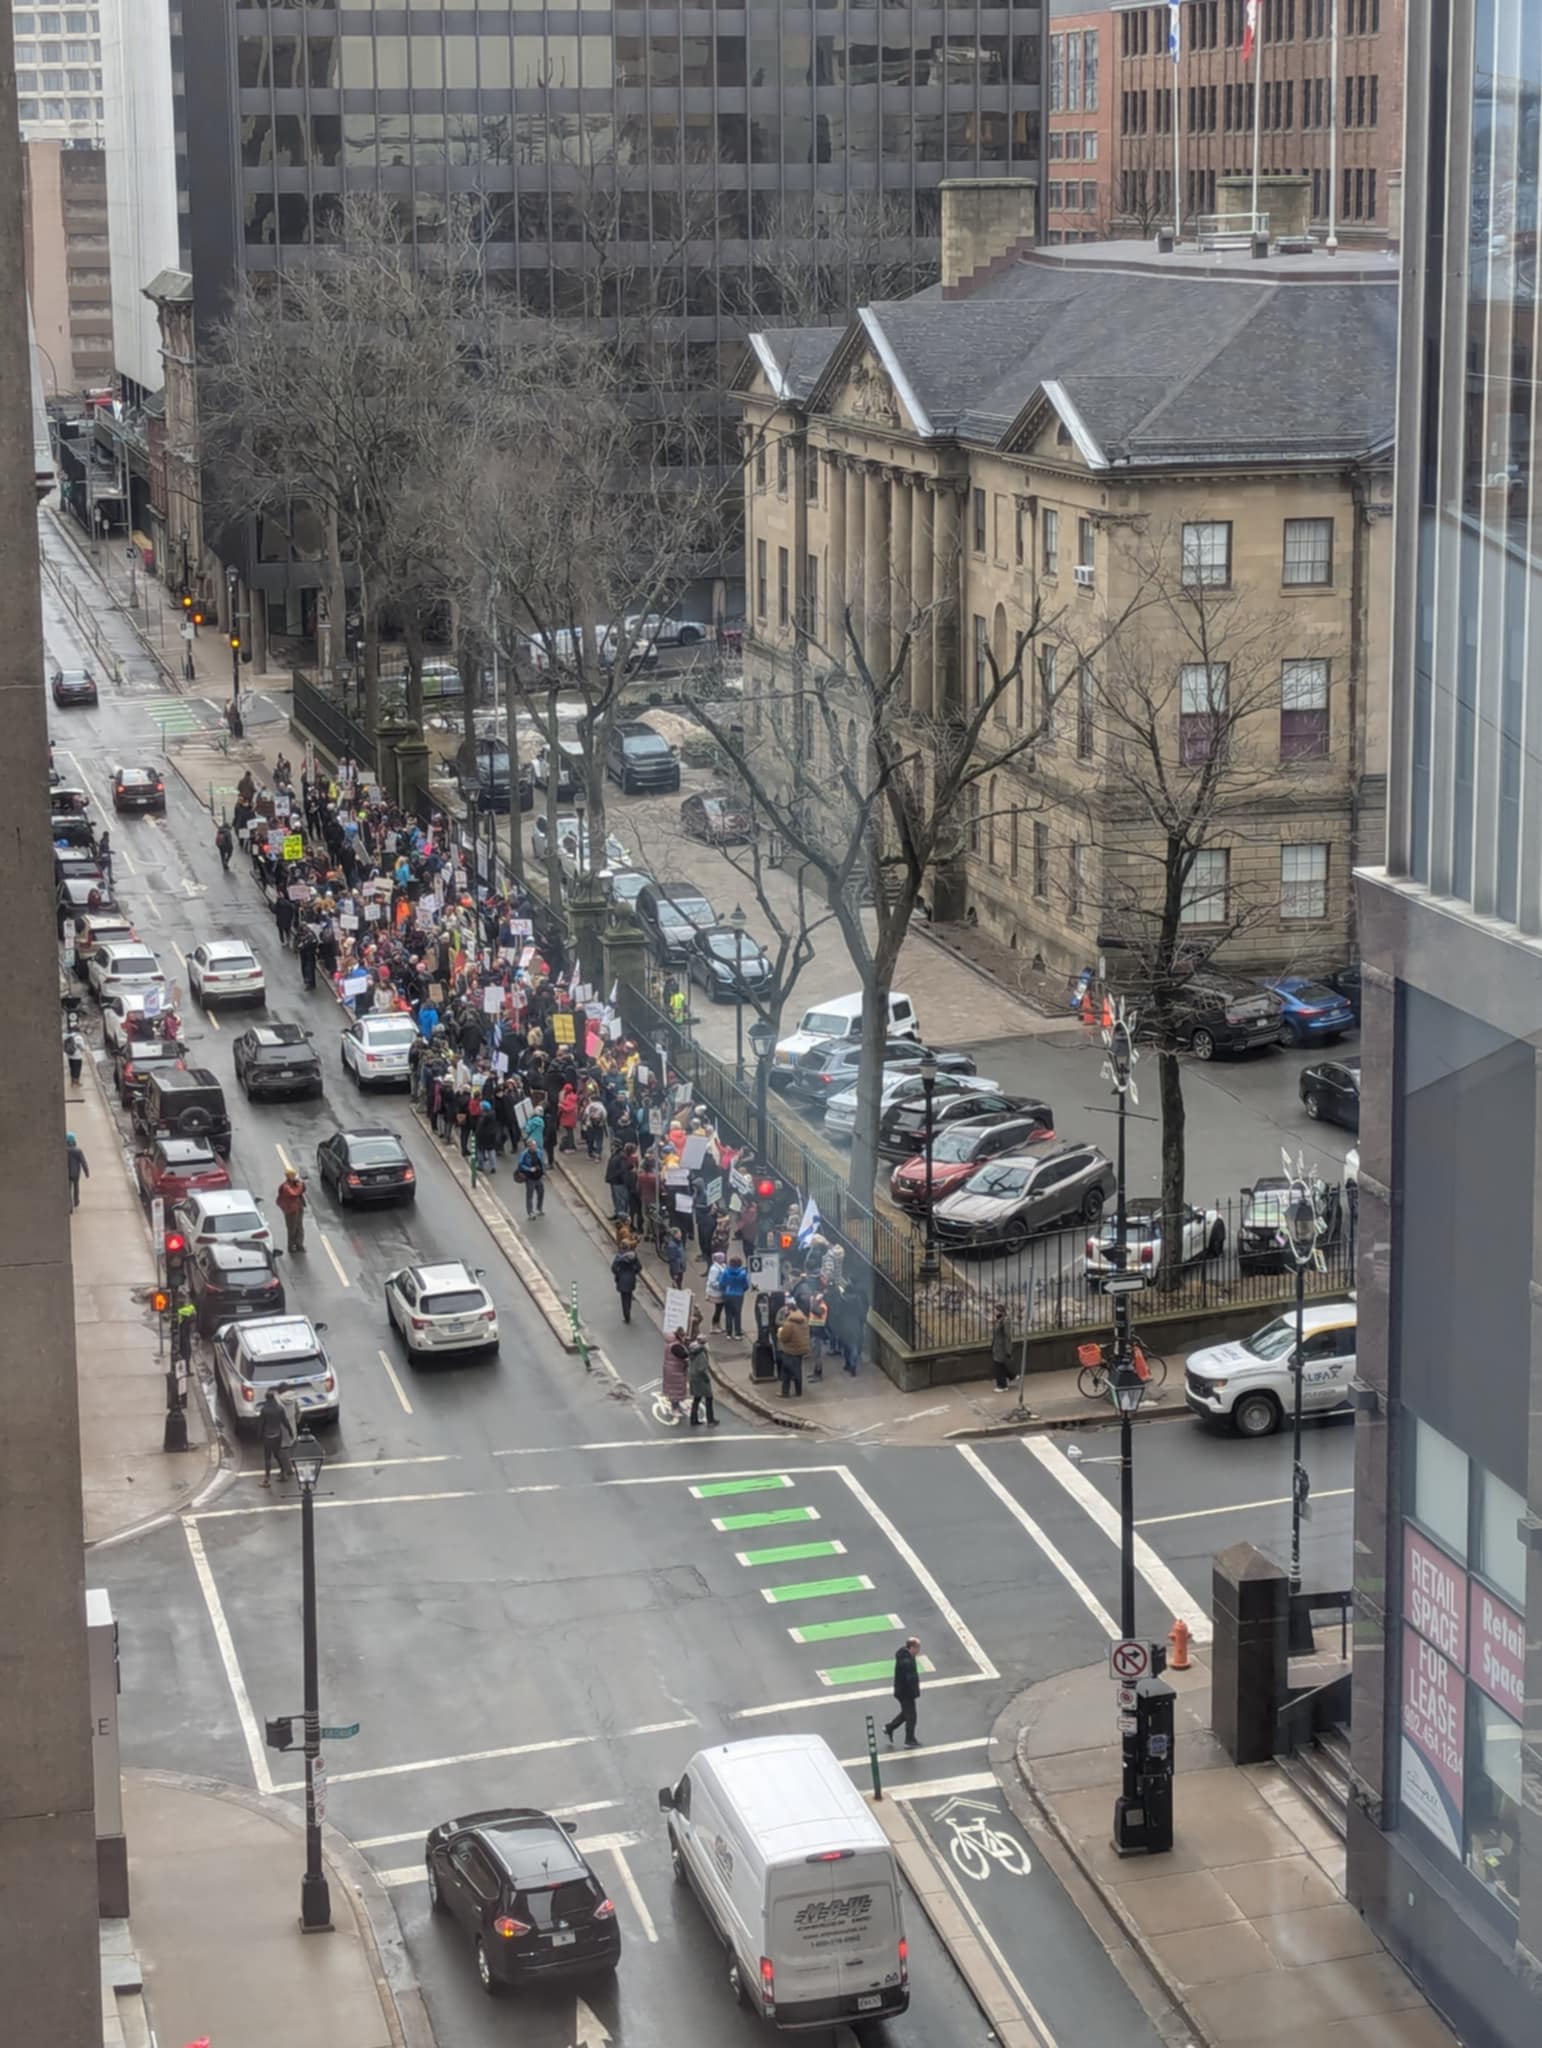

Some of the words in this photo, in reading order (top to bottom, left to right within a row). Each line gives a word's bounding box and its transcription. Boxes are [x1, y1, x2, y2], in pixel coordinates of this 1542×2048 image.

[1411, 1549, 1459, 1619] RETAIL
[1411, 1589, 1459, 1660] SPACE
[1419, 1639, 1448, 1694] FOR
[1482, 1642, 1524, 1703] Space
[98, 1717, 110, 1736] E
[1409, 1669, 1457, 1745] LEASE
